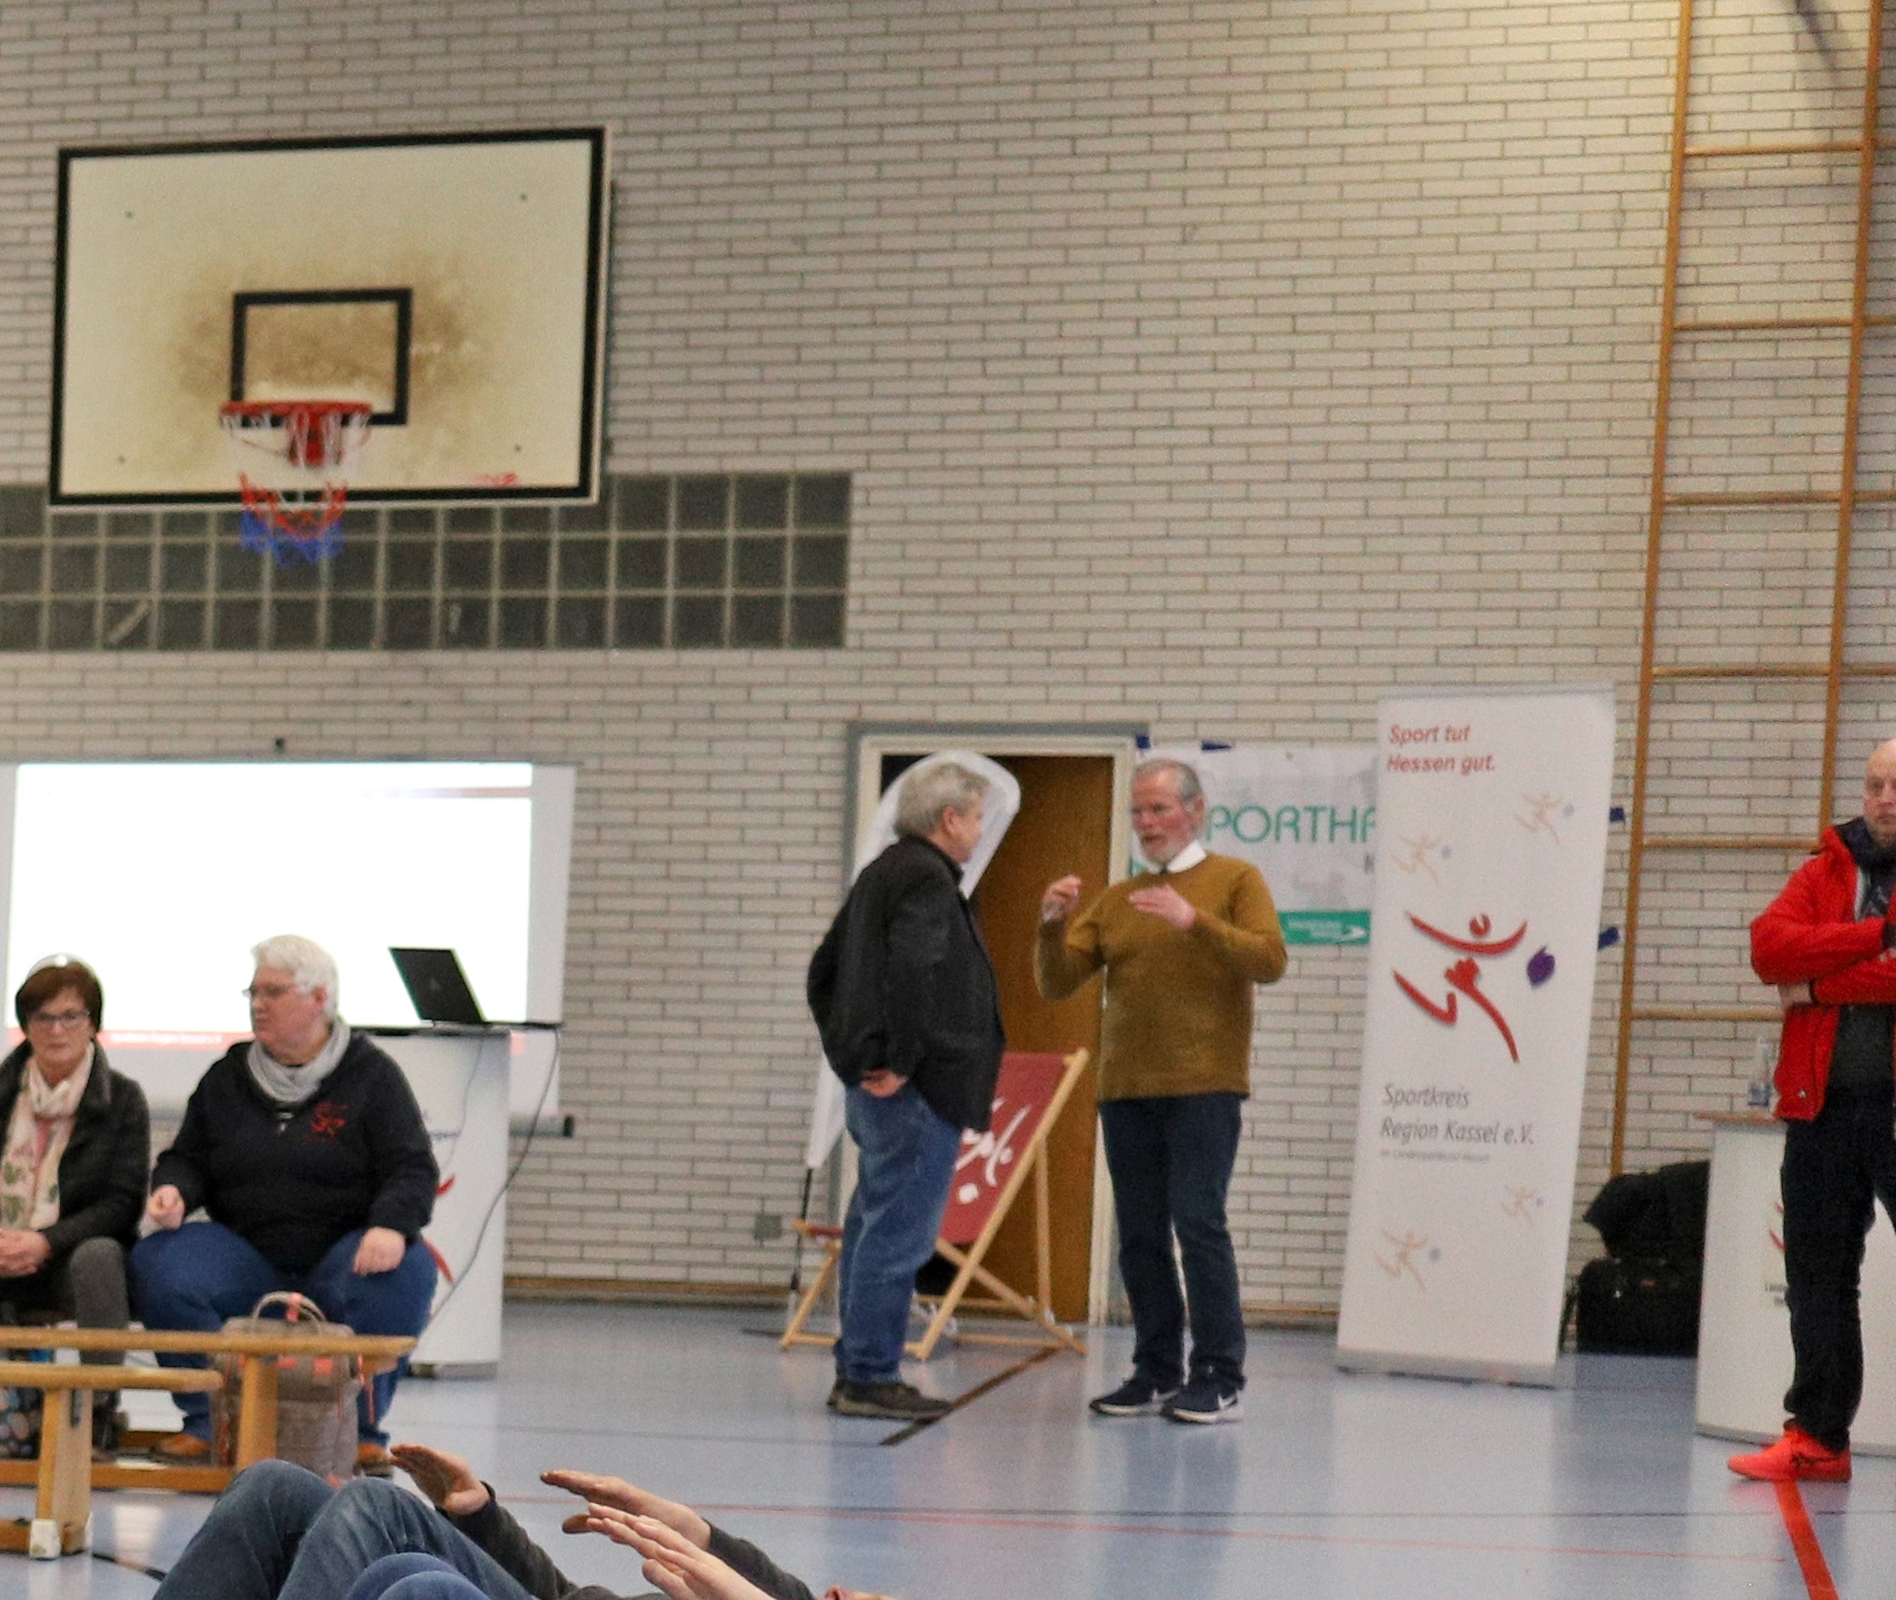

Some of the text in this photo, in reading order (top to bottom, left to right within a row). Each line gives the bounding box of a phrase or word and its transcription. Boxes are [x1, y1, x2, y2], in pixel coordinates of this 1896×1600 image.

[1389, 724, 1471, 747] Sport tut
[1386, 753, 1496, 777] Hessen gut.
[1382, 1082, 1470, 1111] Sportkreis
[1380, 1115, 1536, 1146] Region Kassel e.V.
